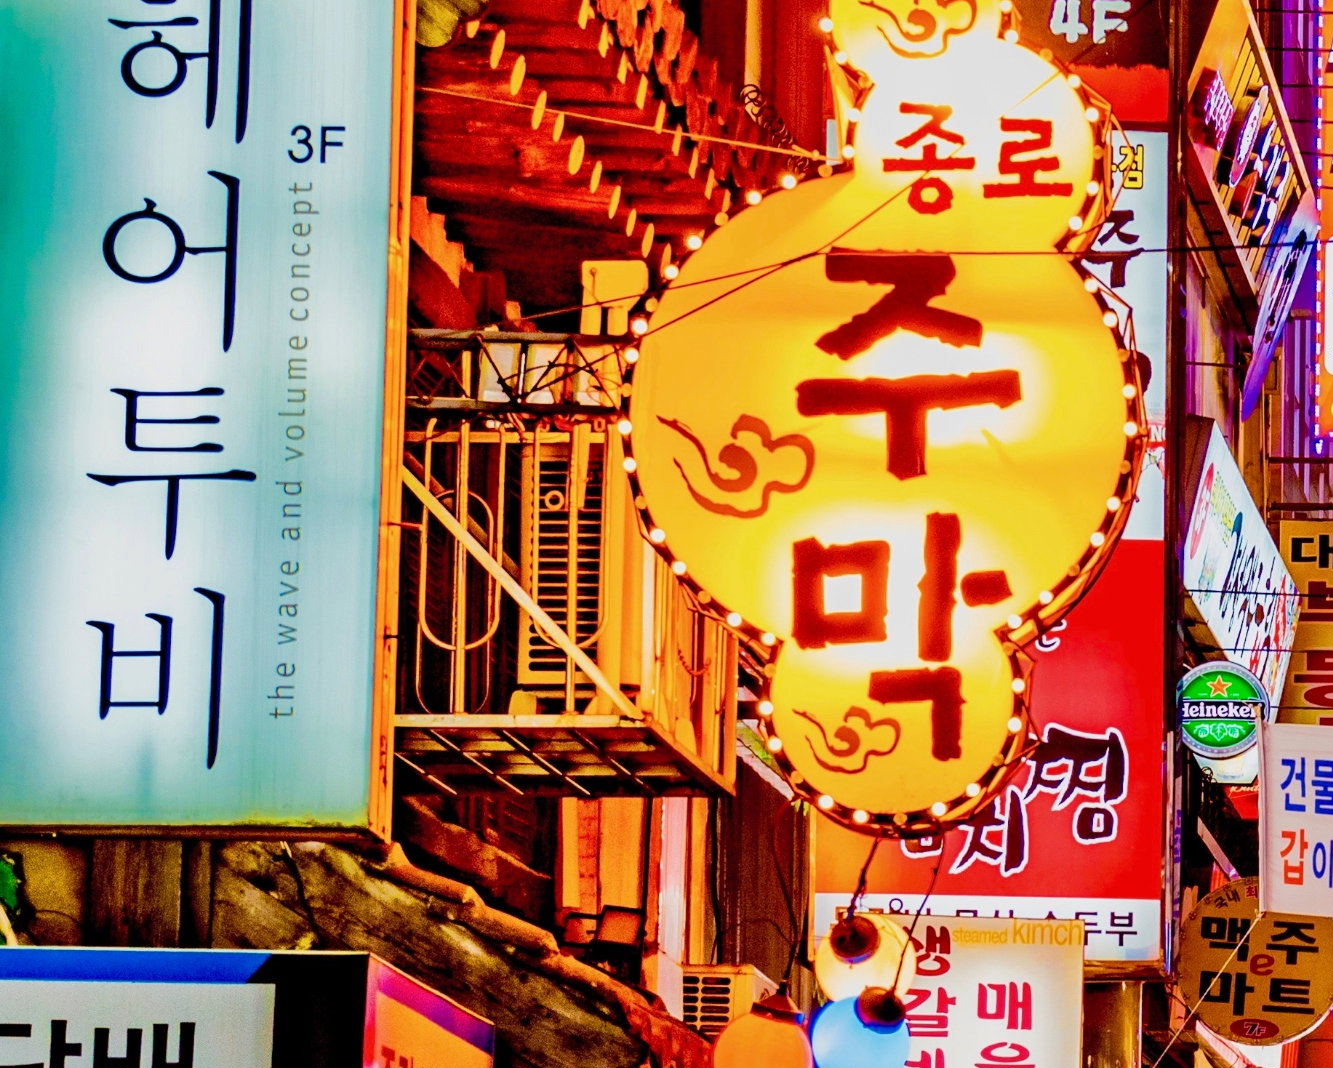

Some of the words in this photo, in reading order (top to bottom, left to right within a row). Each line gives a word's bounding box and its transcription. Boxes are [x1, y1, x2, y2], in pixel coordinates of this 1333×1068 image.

[287, 125, 347, 164] 3F
[883, 102, 1073, 215] 종로
[290, 181, 320, 322] concept
[277, 335, 311, 462] volume
[281, 481, 305, 540] and
[792, 248, 1022, 762] 주막
[276, 559, 302, 646] wave
[269, 664, 296, 719] the
[1280, 829, 1333, 888] 갑이
[952, 926, 1009, 945] steamed
[1201, 916, 1319, 965] 맥주
[1199, 971, 1315, 1016] 마트
